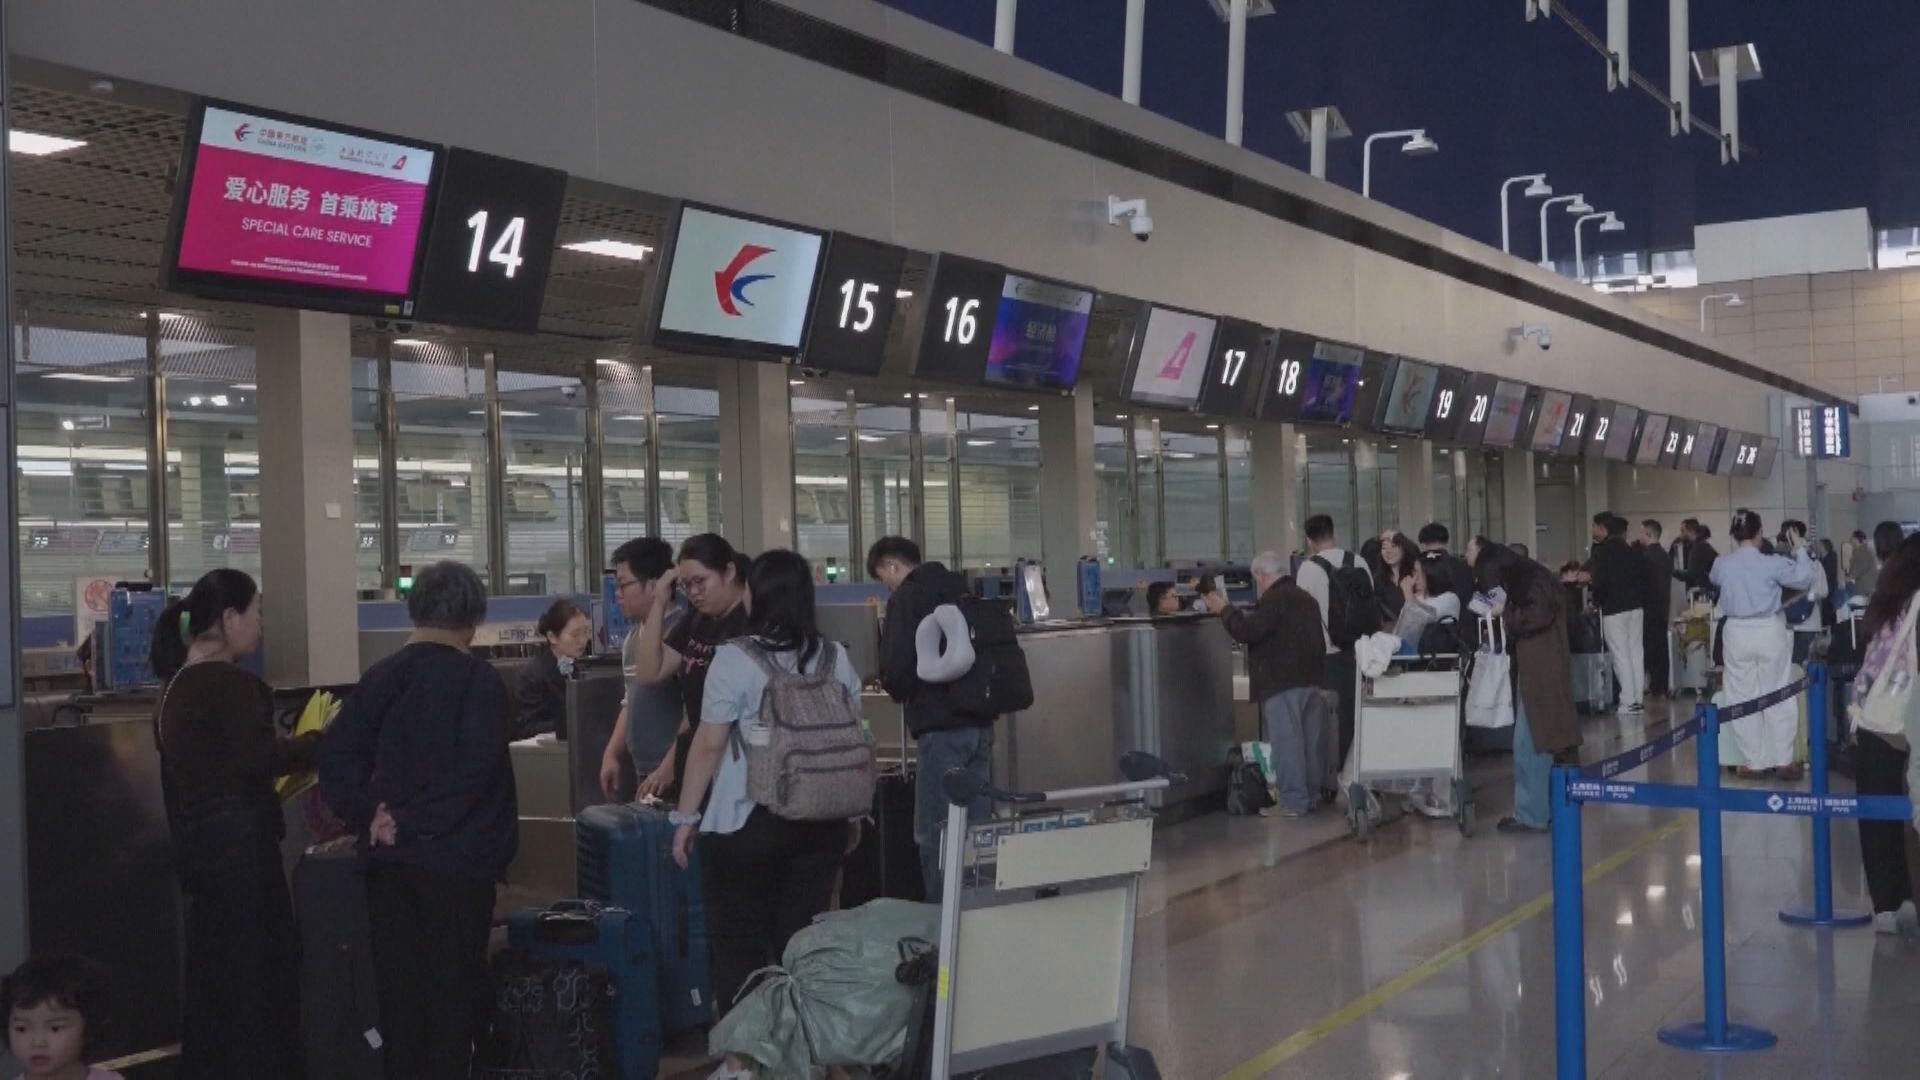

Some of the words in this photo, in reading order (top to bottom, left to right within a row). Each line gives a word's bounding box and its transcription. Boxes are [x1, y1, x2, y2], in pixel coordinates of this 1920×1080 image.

[224, 176, 310, 211] 爱心服务
[320, 191, 398, 225] 首乘旅客
[241, 217, 290, 237] SPECIAL
[292, 224, 325, 241] CARE
[326, 230, 373, 248] SERVICE
[467, 210, 525, 279] 14
[839, 278, 880, 332] 15
[944, 296, 980, 345] 16
[1221, 348, 1246, 387] 17
[1277, 358, 1300, 396] 18
[1436, 388, 1453, 419] 19
[1469, 394, 1488, 423] 20
[1569, 412, 1584, 437] 21
[1594, 415, 1609, 441] 22
[1665, 431, 1679, 453] 23
[1683, 434, 1694, 455] 24
